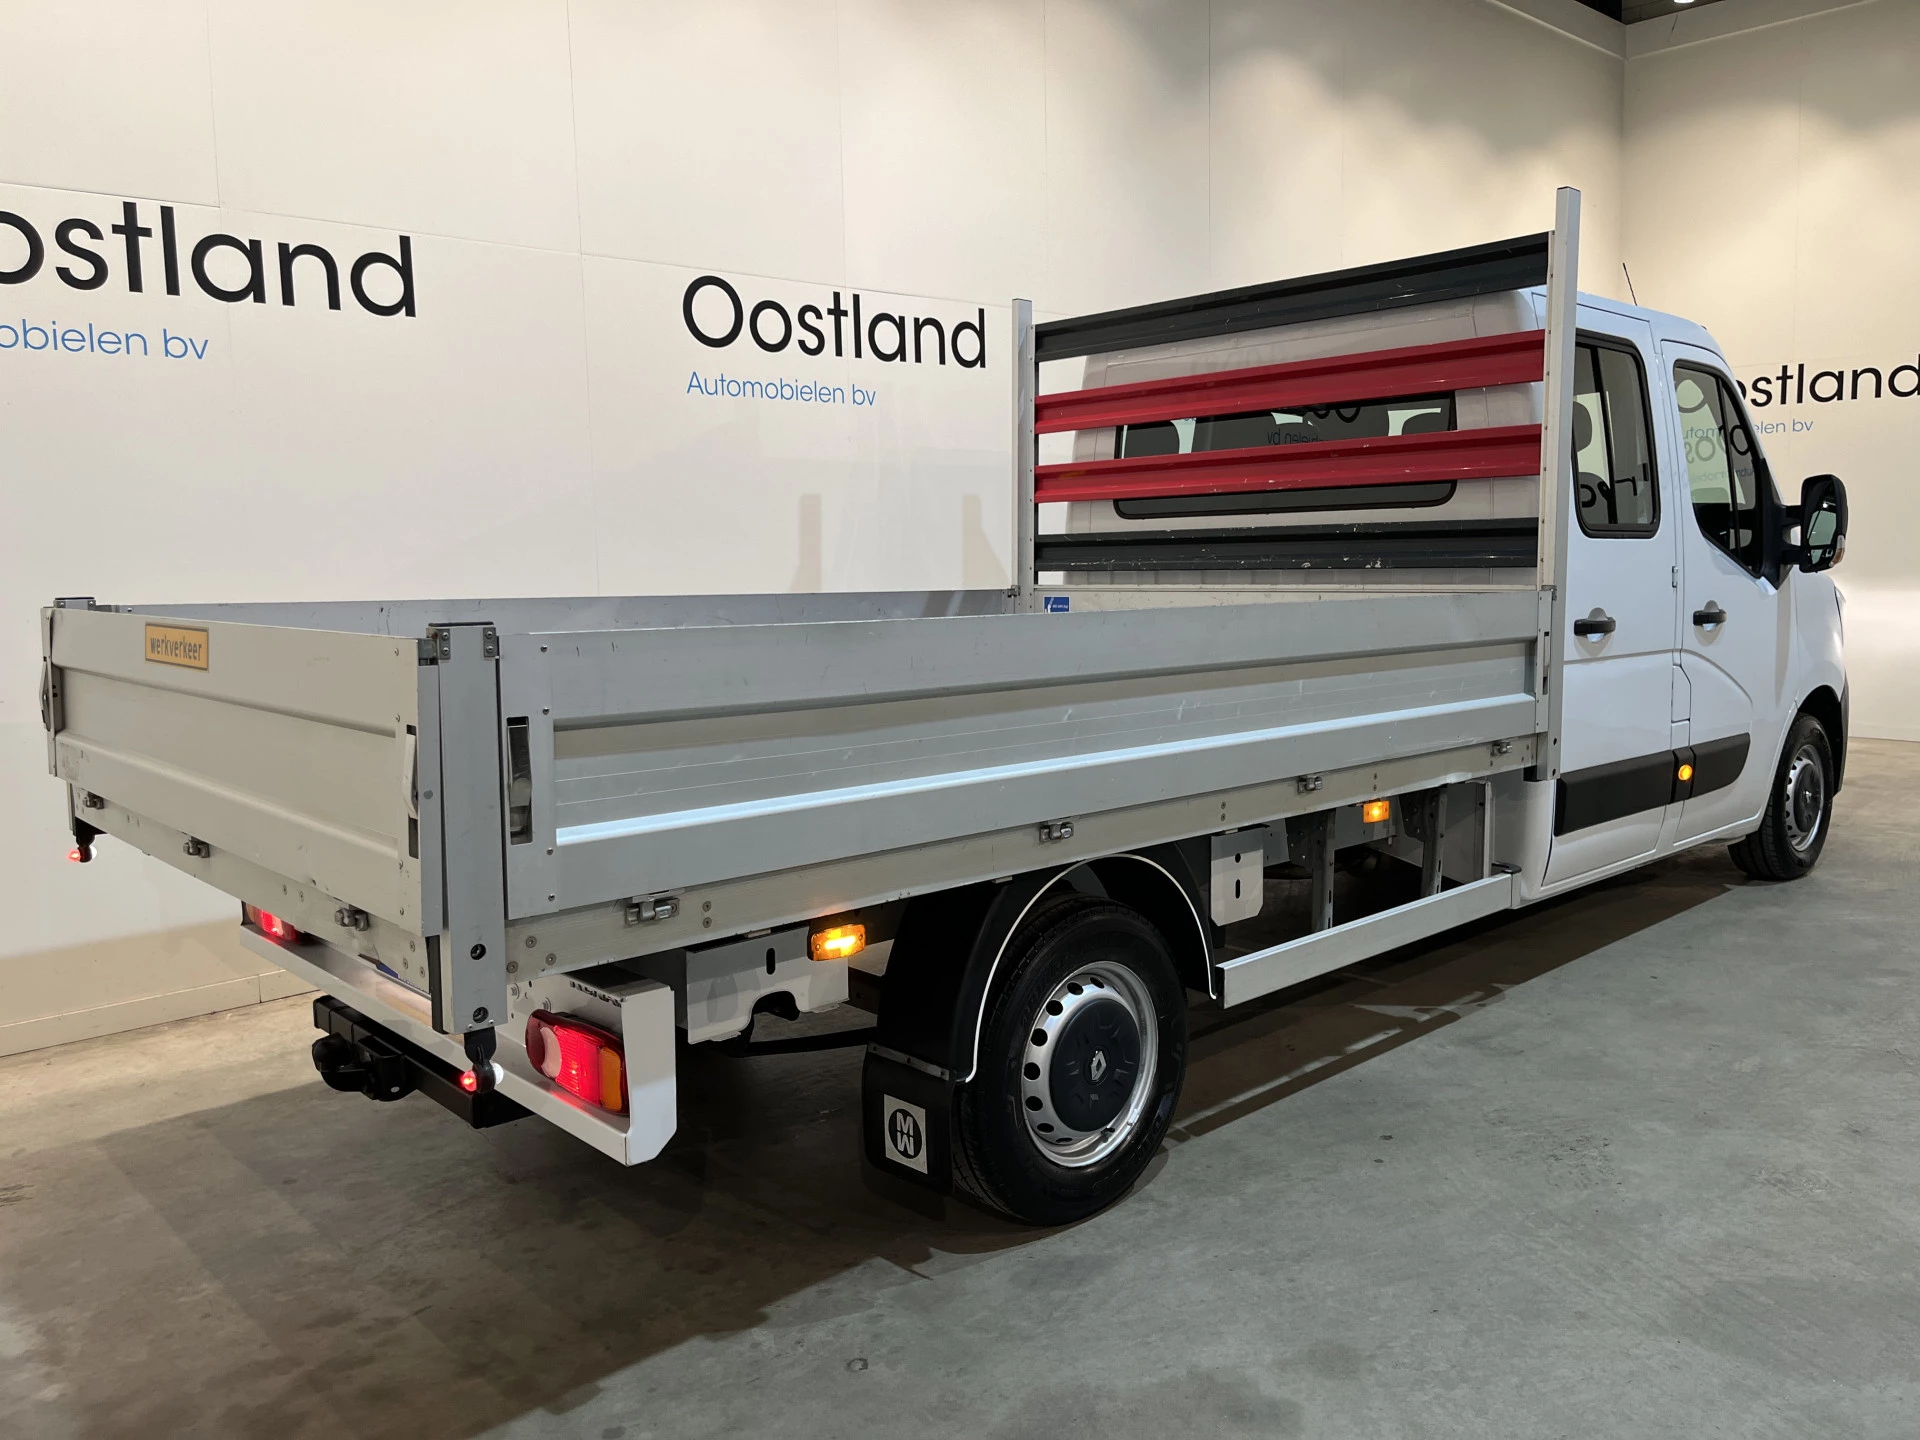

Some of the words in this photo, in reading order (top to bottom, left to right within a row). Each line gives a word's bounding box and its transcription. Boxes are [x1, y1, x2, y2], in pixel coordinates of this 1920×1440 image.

[683, 275, 986, 368] Oostland
[163, 328, 209, 359] bv
[687, 371, 845, 404] Automobielen
[852, 384, 876, 406] bv
[1792, 418, 1814, 433] bv
[150, 634, 202, 661] werkverkeer
